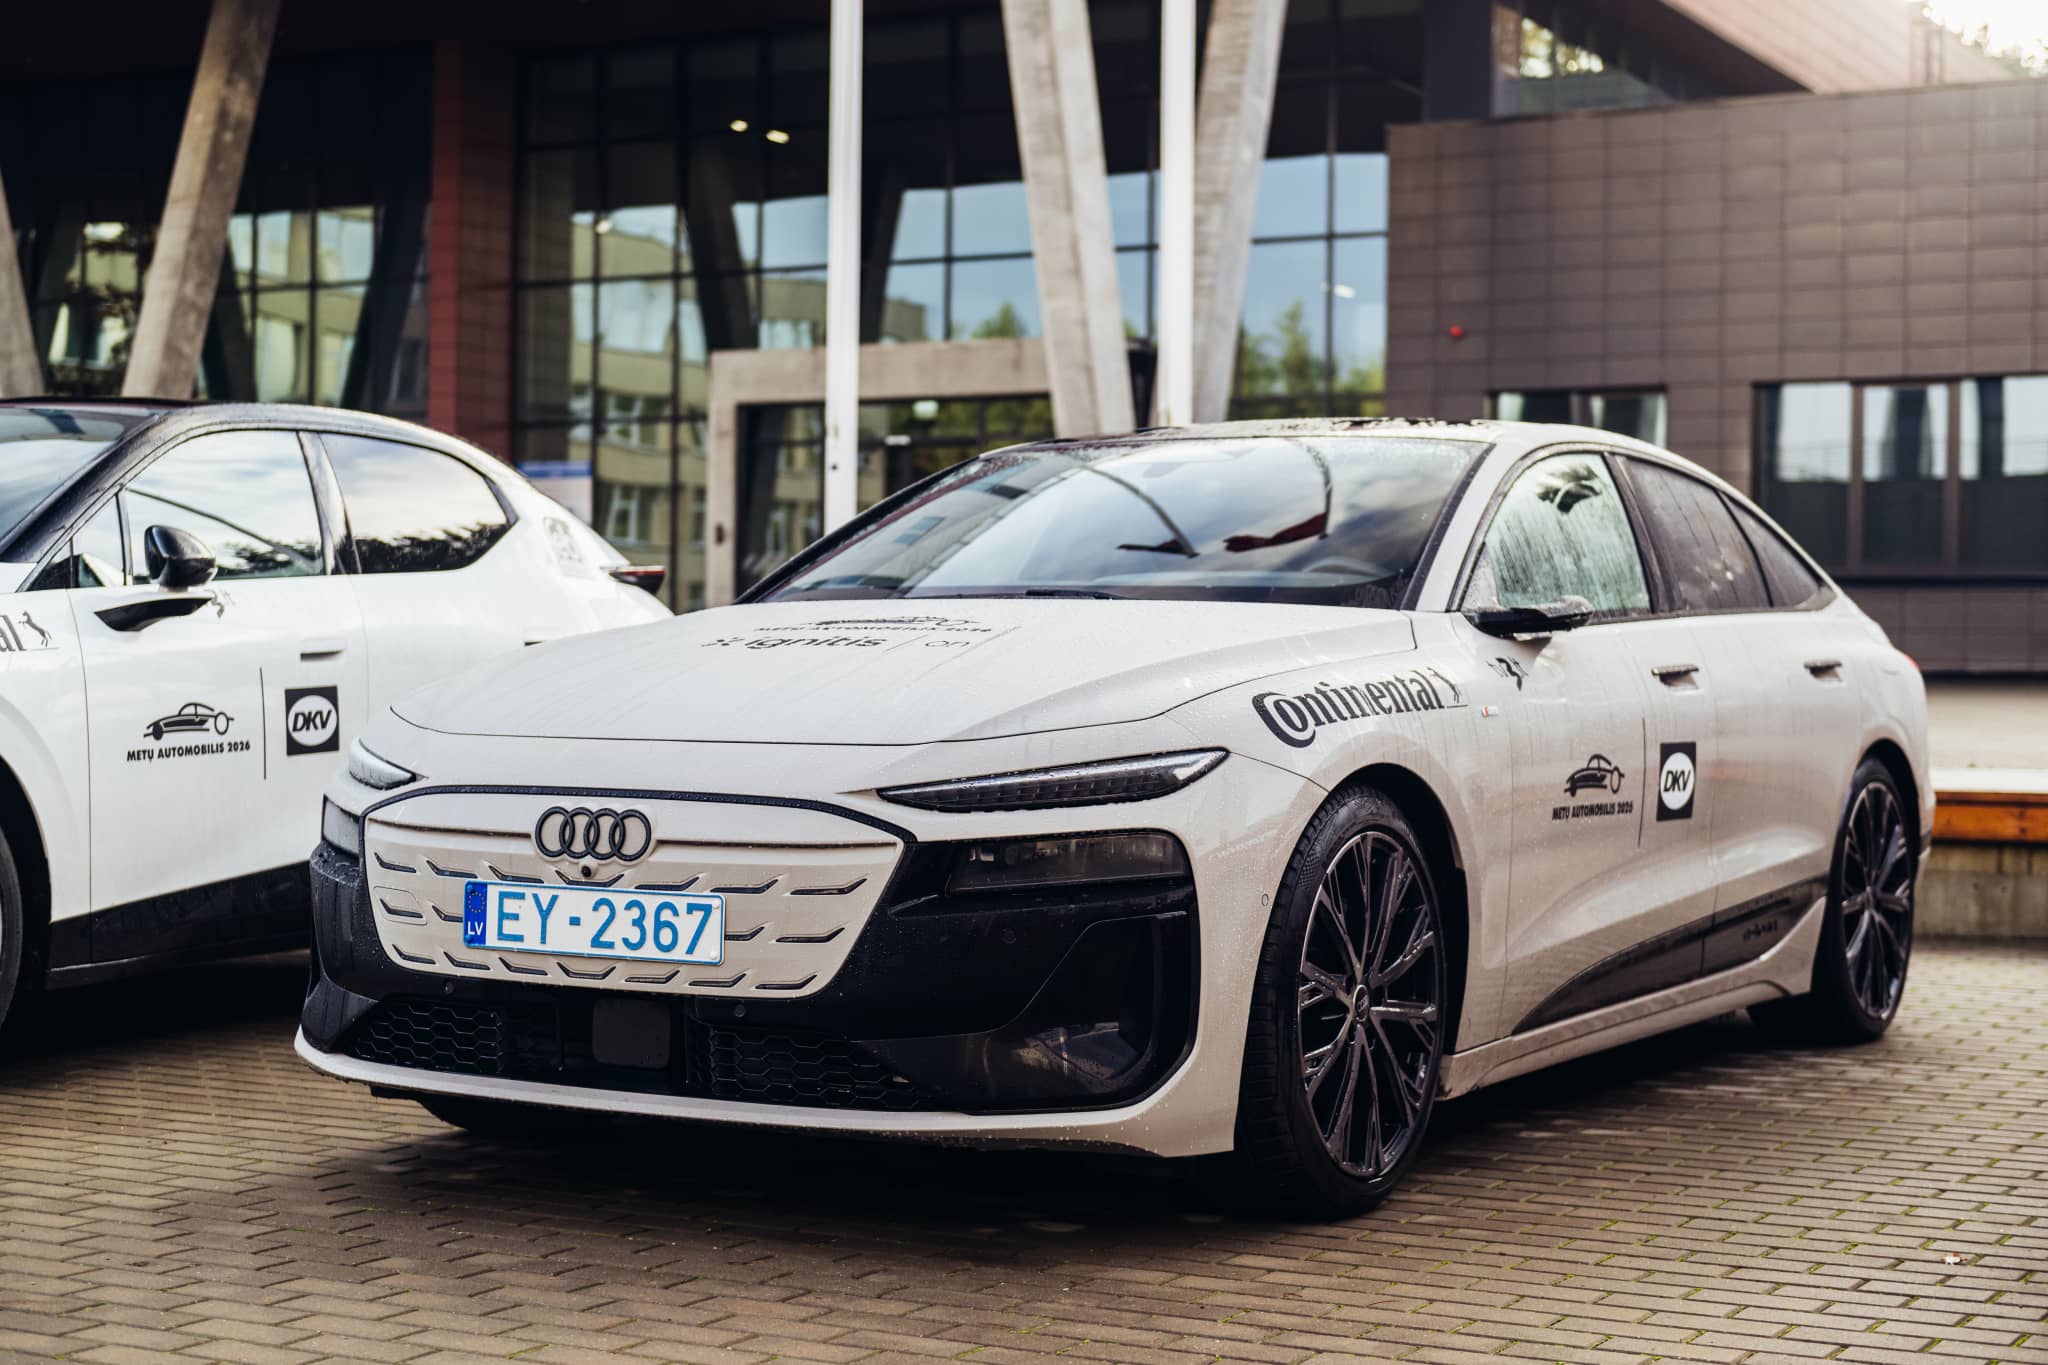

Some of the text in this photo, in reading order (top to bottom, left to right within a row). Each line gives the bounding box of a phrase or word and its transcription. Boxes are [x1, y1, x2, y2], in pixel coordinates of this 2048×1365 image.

[744, 635, 970, 649] ignitis on
[1252, 669, 1445, 748] Continental
[292, 708, 333, 732] DKV
[157, 743, 225, 759] AUTOMOBILIS
[228, 740, 250, 753] 2026
[1663, 769, 1692, 792] DKV
[1571, 802, 1616, 818] AUTOMOBILIS
[1617, 801, 1634, 814] 2026
[467, 920, 484, 936] LV
[497, 890, 713, 955] EY-2367
